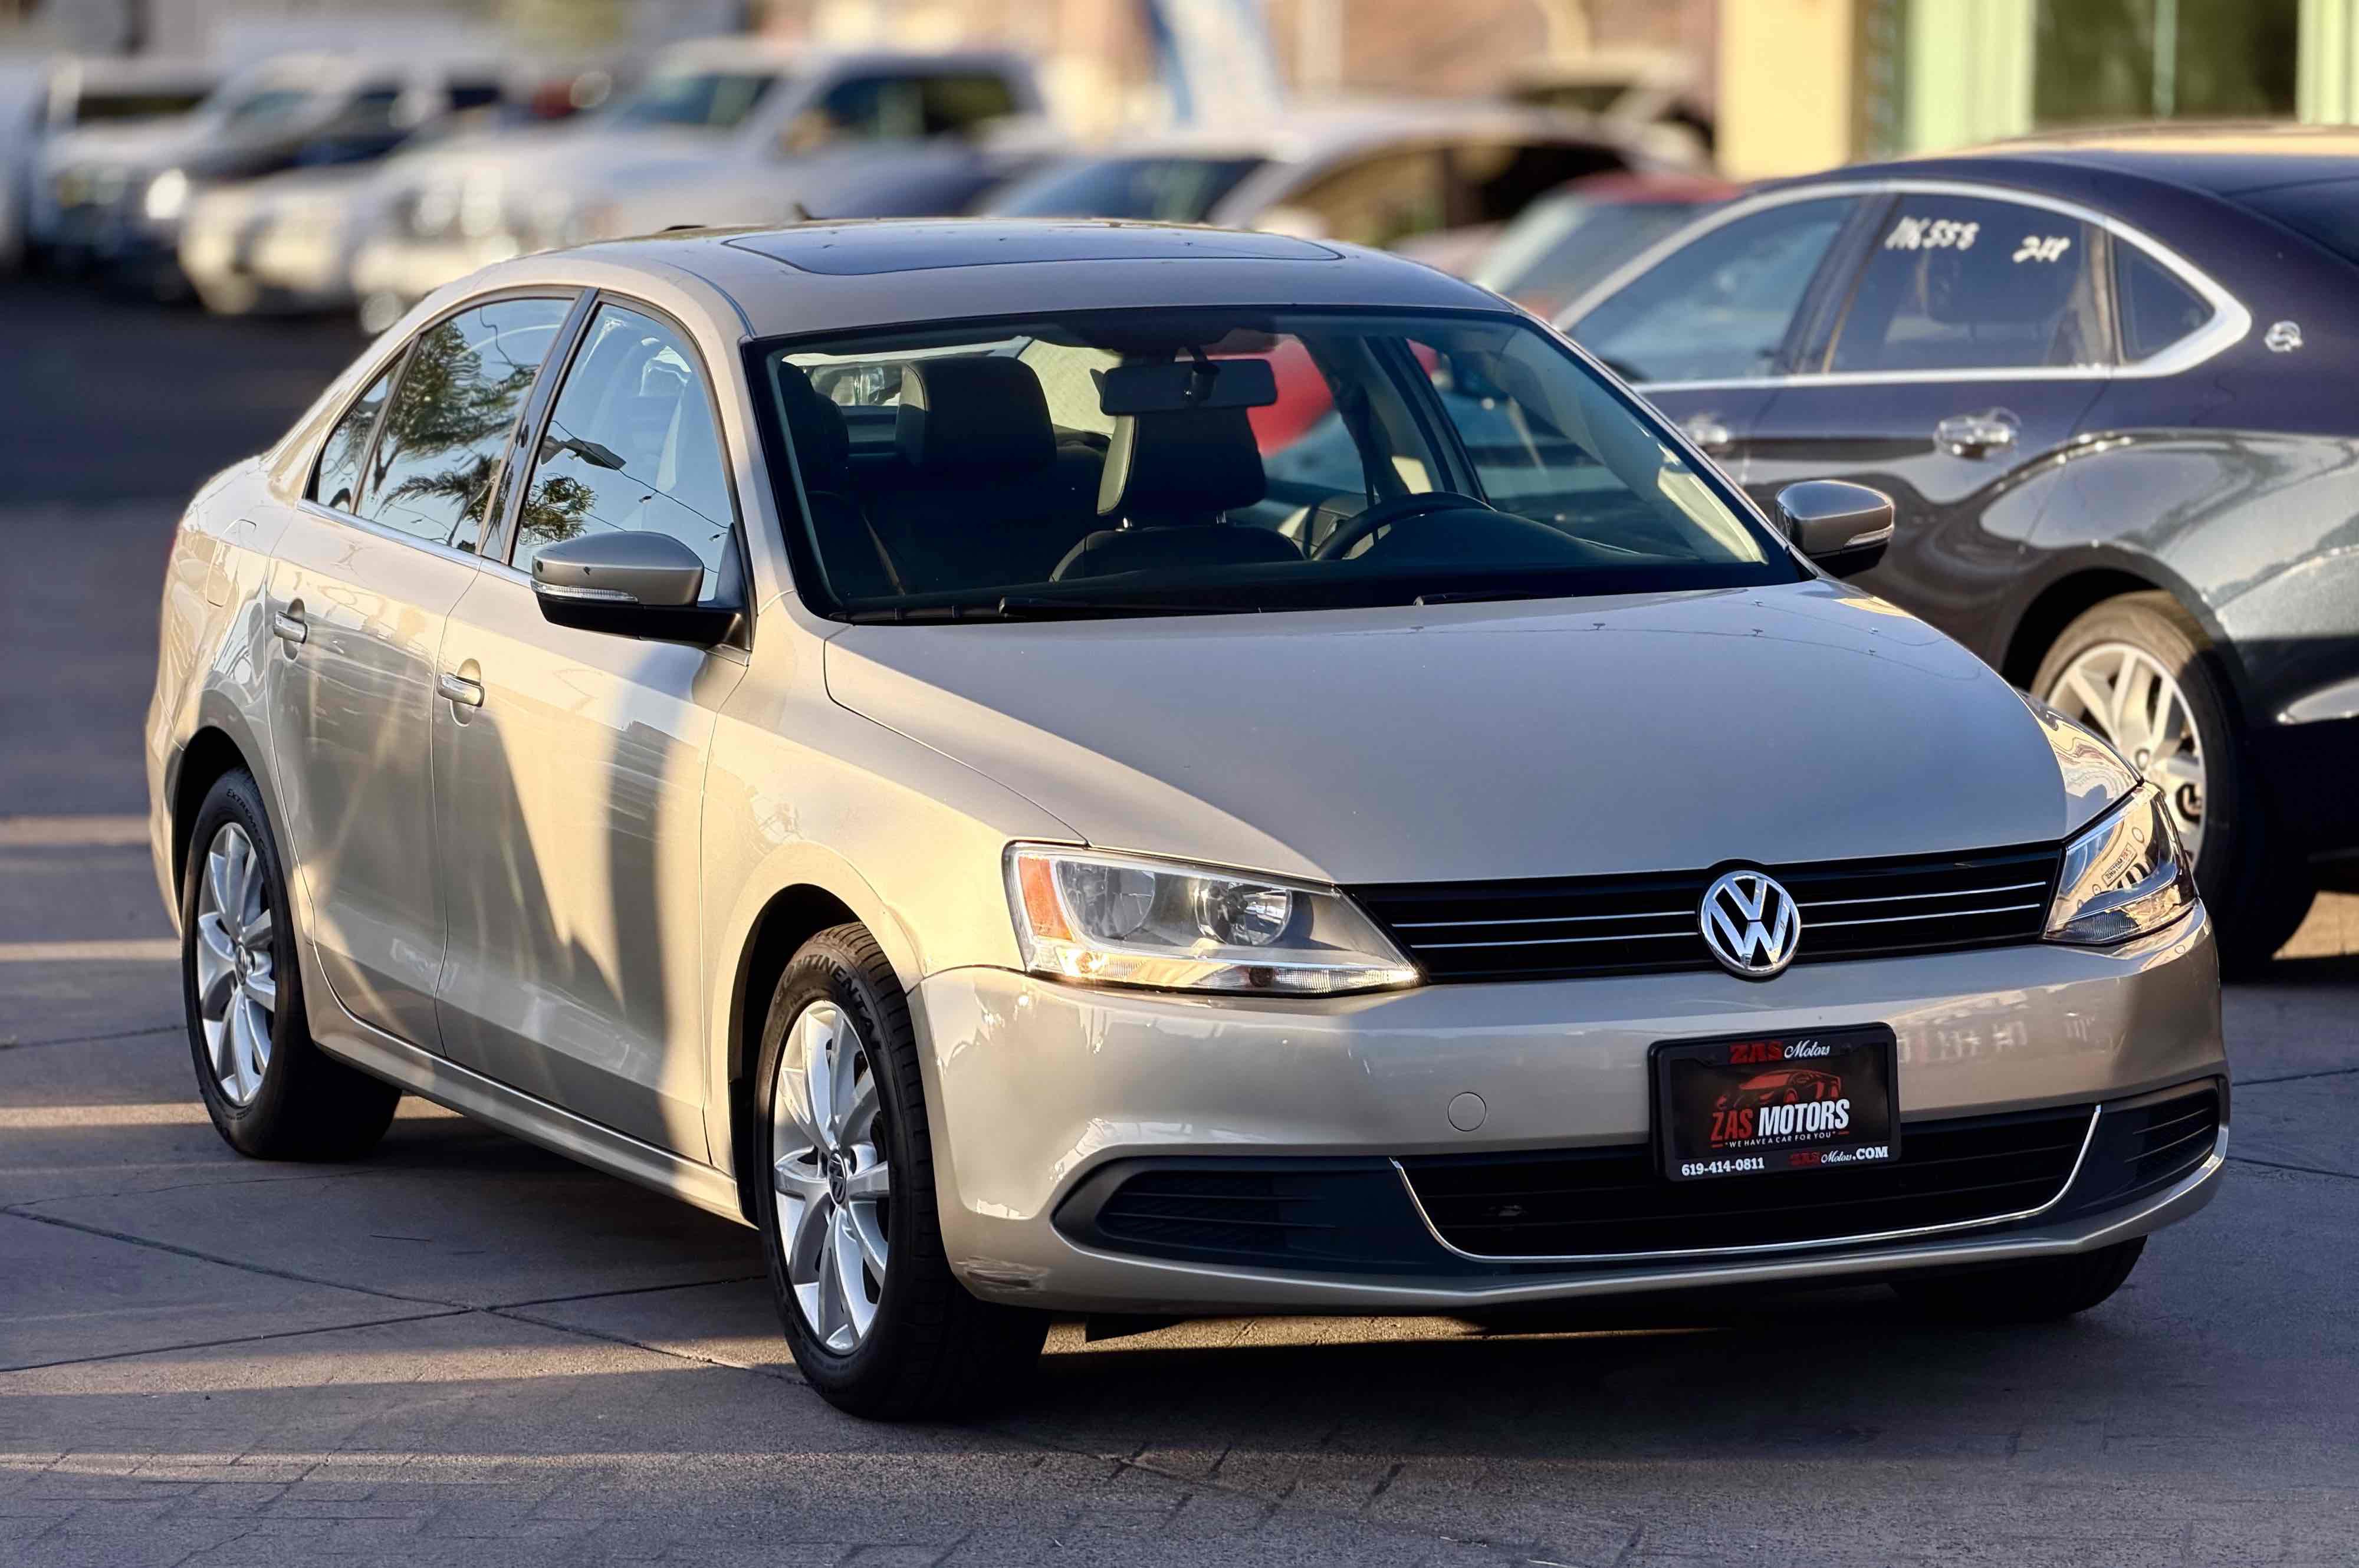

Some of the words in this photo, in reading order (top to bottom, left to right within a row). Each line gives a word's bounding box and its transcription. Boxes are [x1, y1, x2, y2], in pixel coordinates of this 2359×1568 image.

[1729, 1041, 1783, 1063] ZAS
[1784, 1040, 1831, 1059] Motors
[1711, 1108, 1754, 1140] ZAS
[1758, 1099, 1850, 1136] MOTORS
[1744, 1138, 1766, 1146] HAVE
[1776, 1135, 1792, 1143] CAR
[1681, 1157, 1765, 1176] 619-414-0811
